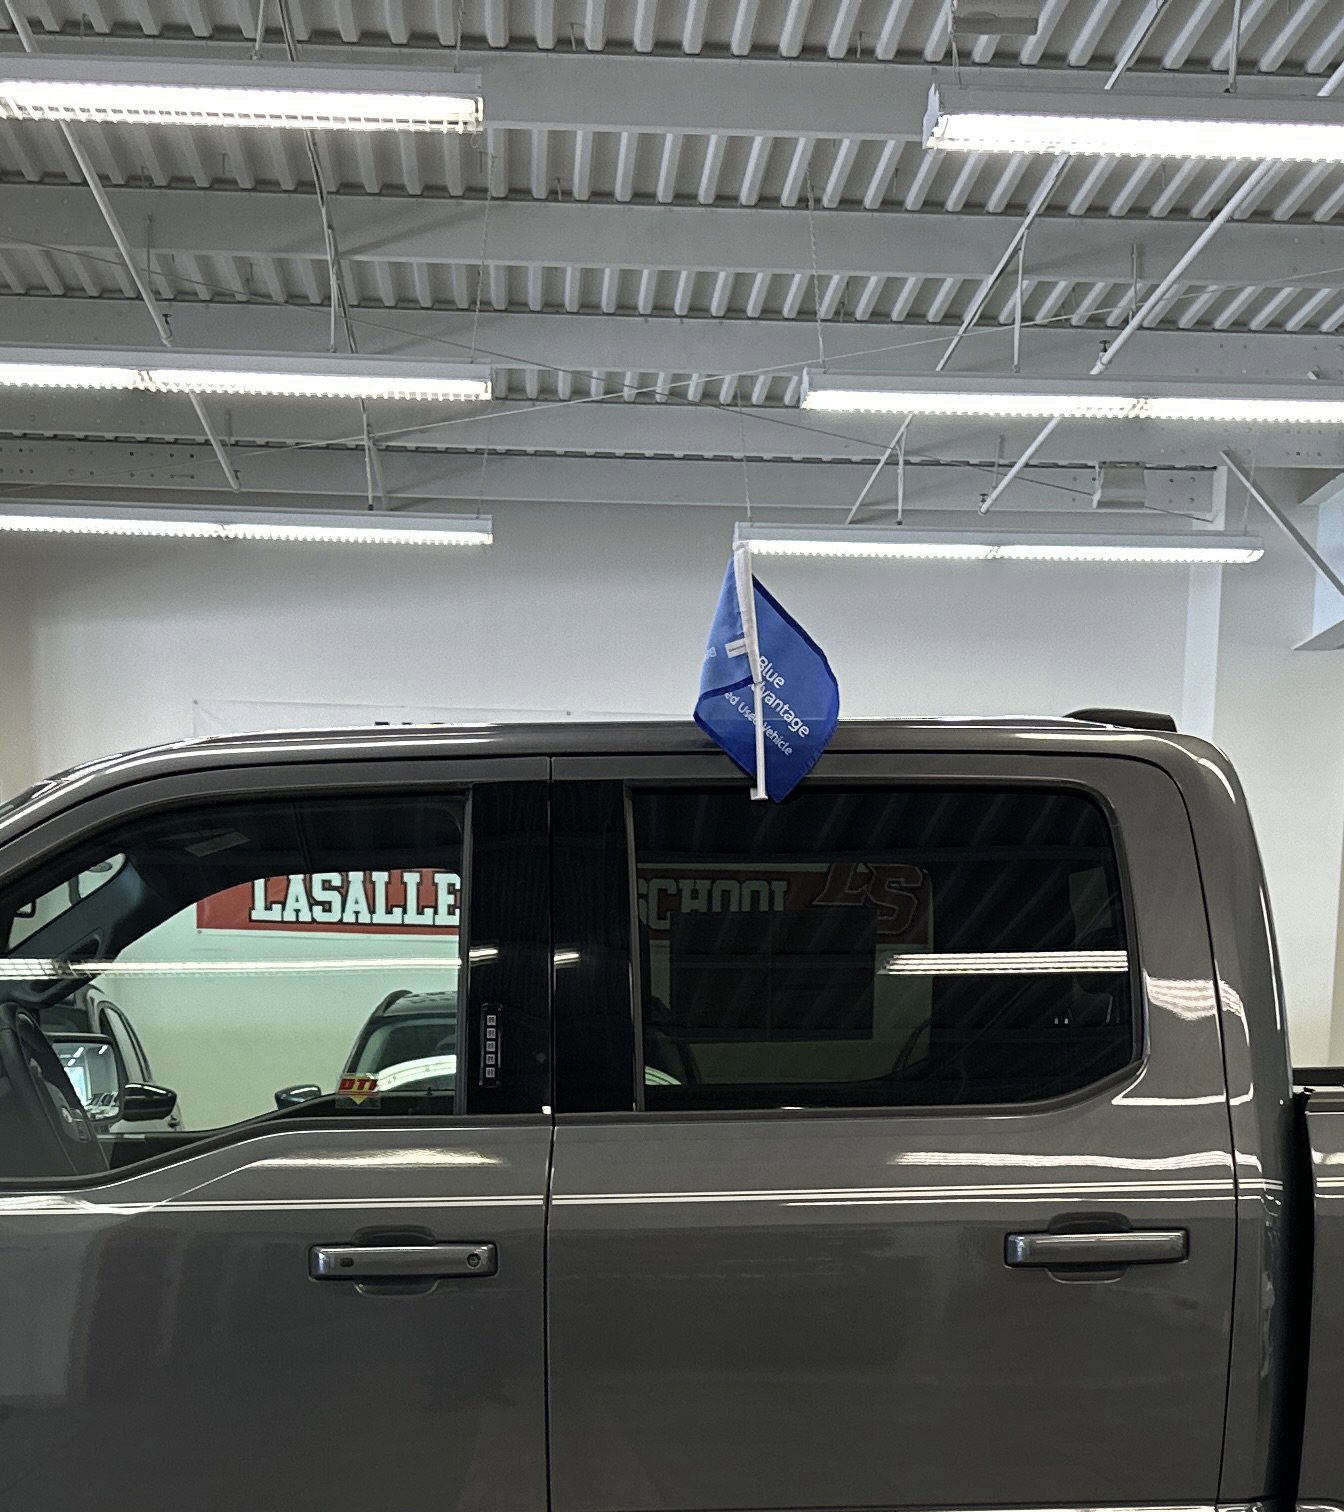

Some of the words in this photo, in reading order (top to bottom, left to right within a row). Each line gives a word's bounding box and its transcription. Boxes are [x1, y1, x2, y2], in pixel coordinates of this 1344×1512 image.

[758, 656, 785, 688] Blue
[751, 681, 810, 738] vantage
[249, 870, 460, 926] LASALLE
